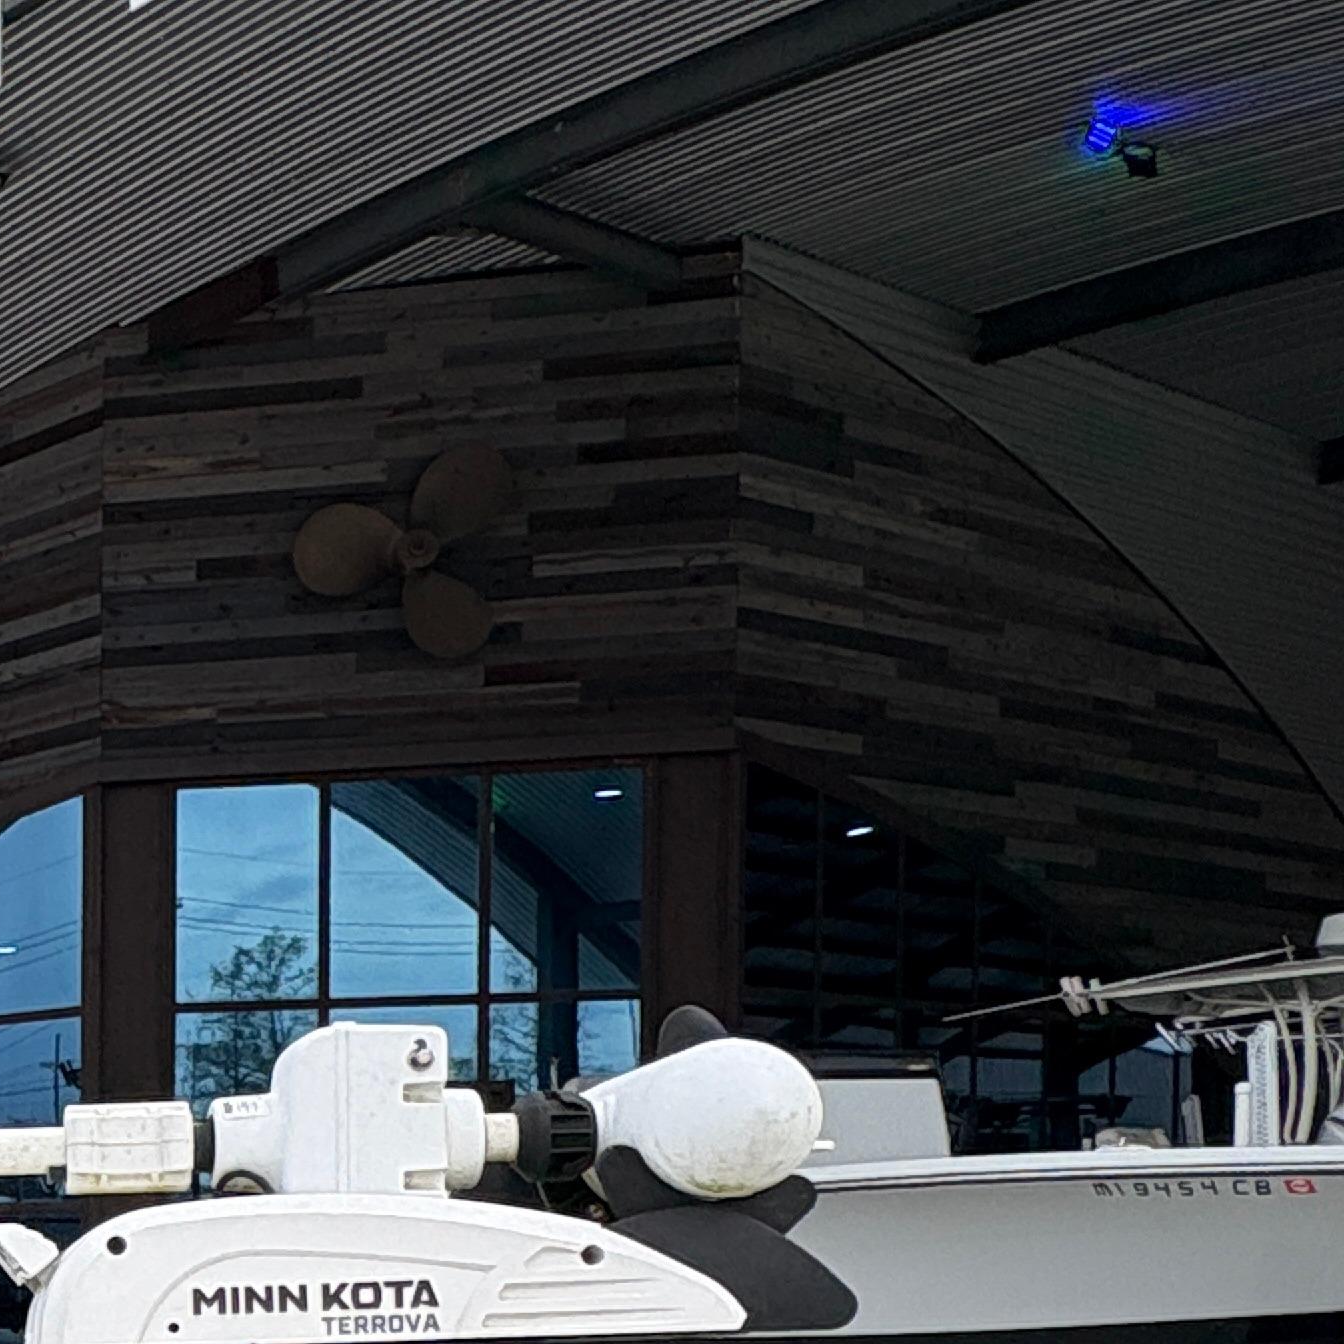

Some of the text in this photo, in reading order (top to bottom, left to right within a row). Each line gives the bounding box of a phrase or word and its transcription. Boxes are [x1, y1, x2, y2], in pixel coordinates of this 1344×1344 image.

[192, 1279, 440, 1316] MINN KOTA
[321, 1313, 441, 1336] TERROVA
